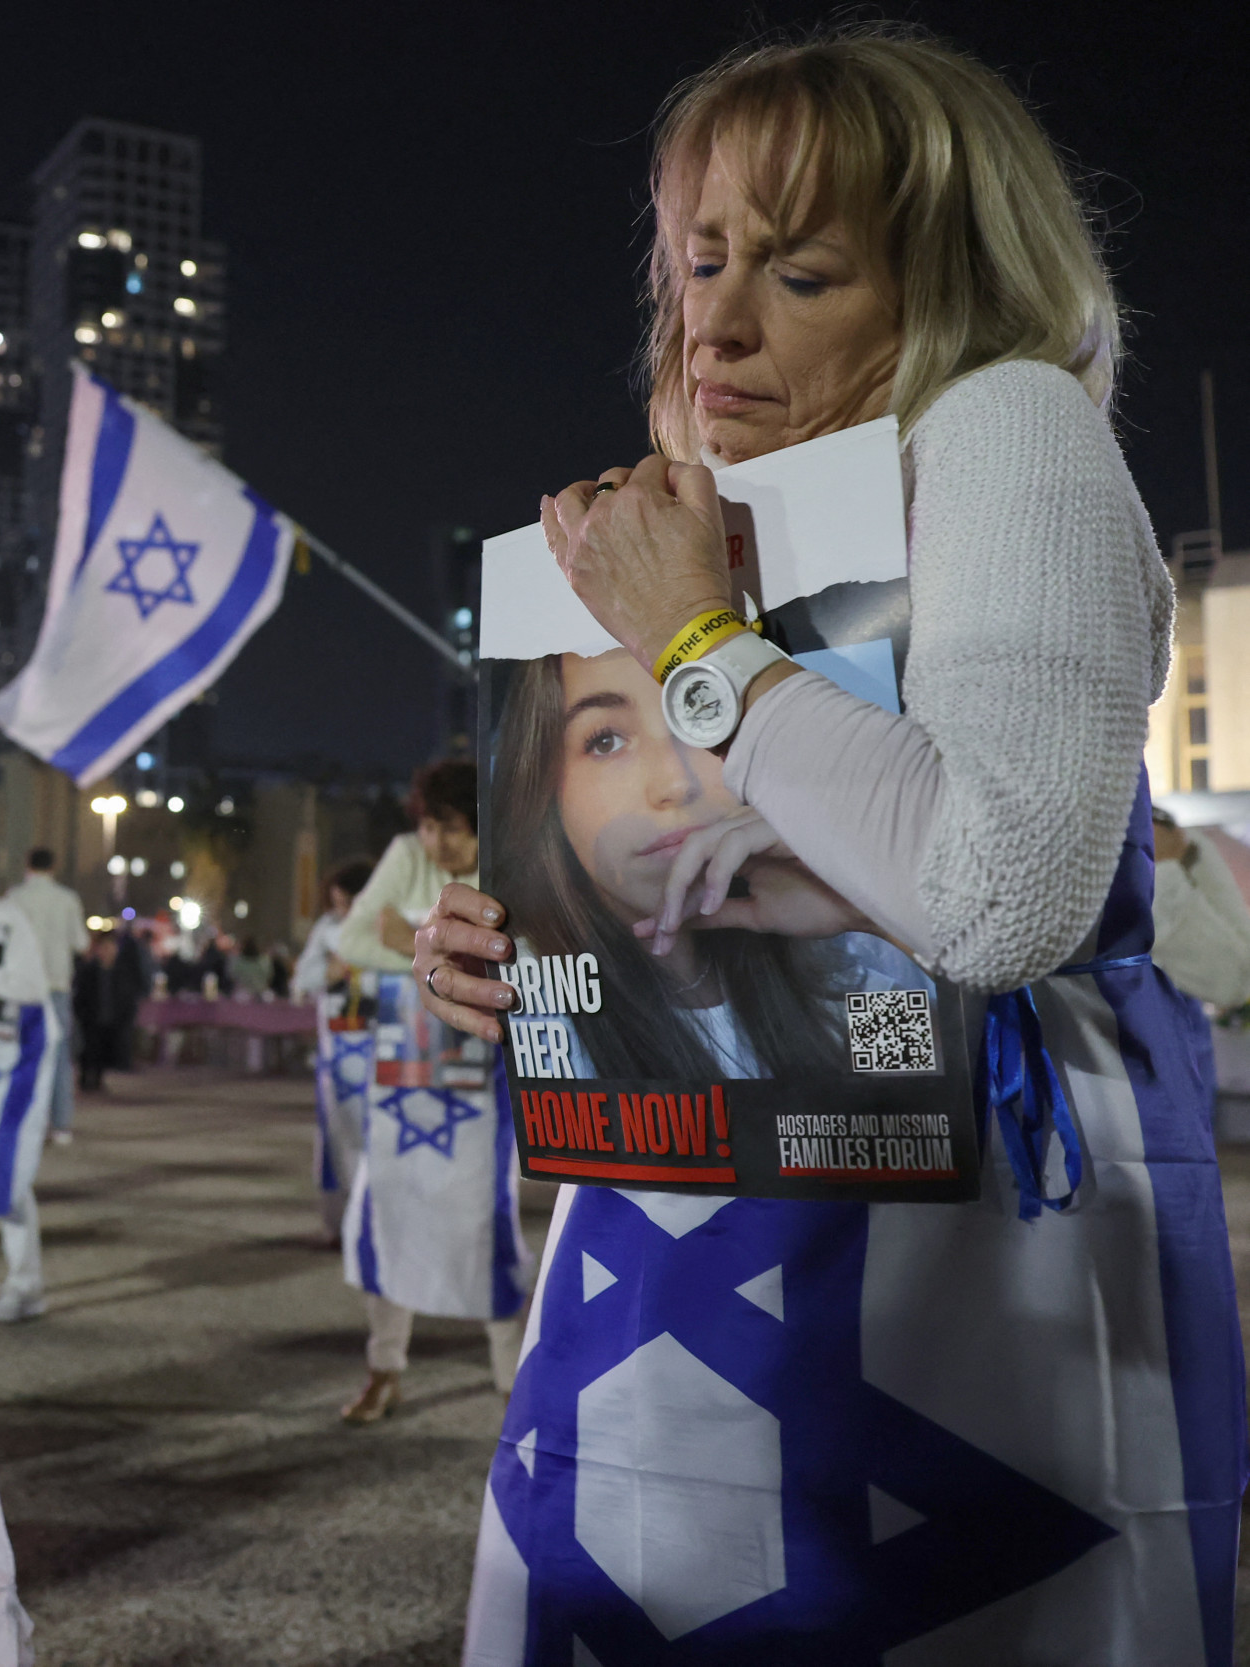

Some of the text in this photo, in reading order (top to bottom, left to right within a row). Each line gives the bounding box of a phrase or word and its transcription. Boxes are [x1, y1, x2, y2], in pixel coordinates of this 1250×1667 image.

[660, 654, 682, 685] RING
[678, 631, 703, 655] THE
[509, 1021, 575, 1079] HER
[520, 1084, 731, 1158] HOME NOW!
[776, 1113, 949, 1137] HOSTAGES AND MISSING
[779, 1137, 954, 1171] FAMILIES FORUM
